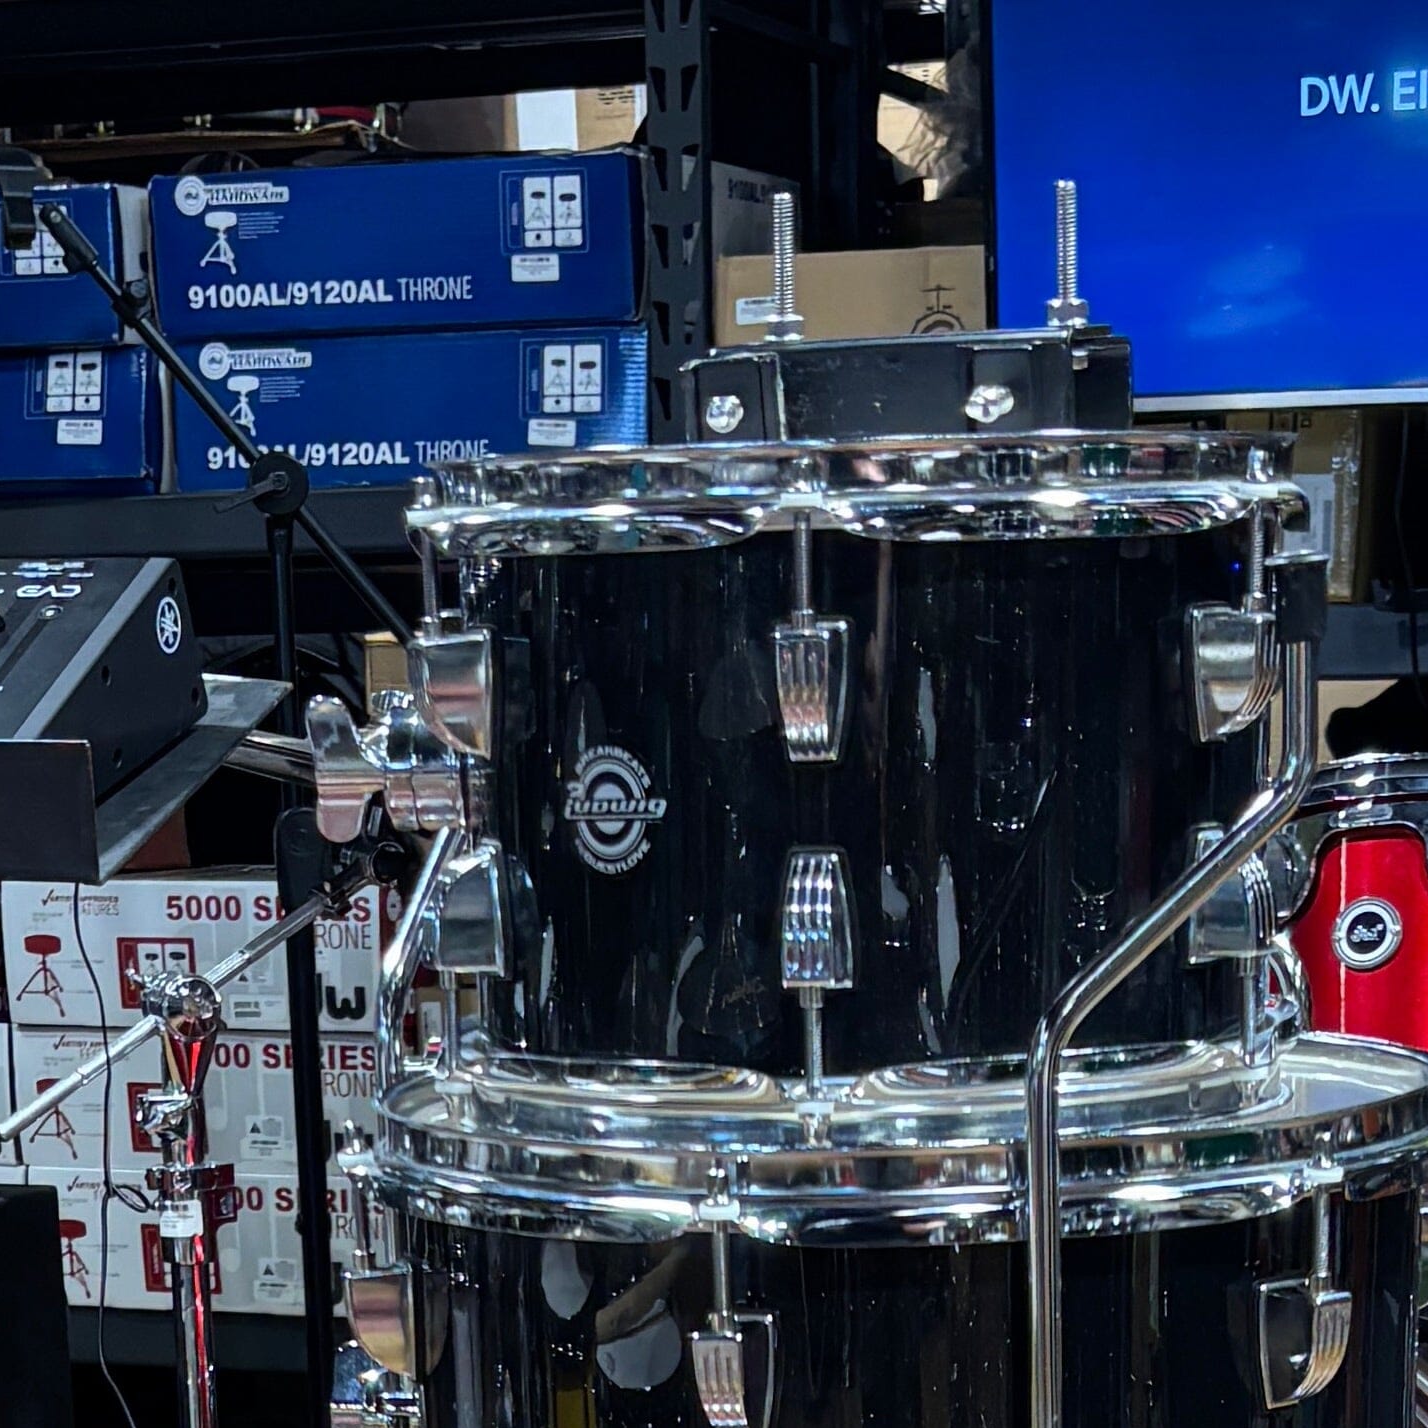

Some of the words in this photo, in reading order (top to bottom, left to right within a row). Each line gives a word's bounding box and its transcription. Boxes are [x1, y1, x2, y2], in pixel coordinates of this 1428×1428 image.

[1301, 70, 1380, 117] DW.
[187, 277, 394, 309] 9100AL/9120AL
[396, 275, 473, 301] THRONE
[166, 895, 242, 921] 5000
[314, 923, 373, 950] RONE
[213, 1043, 250, 1068] 00
